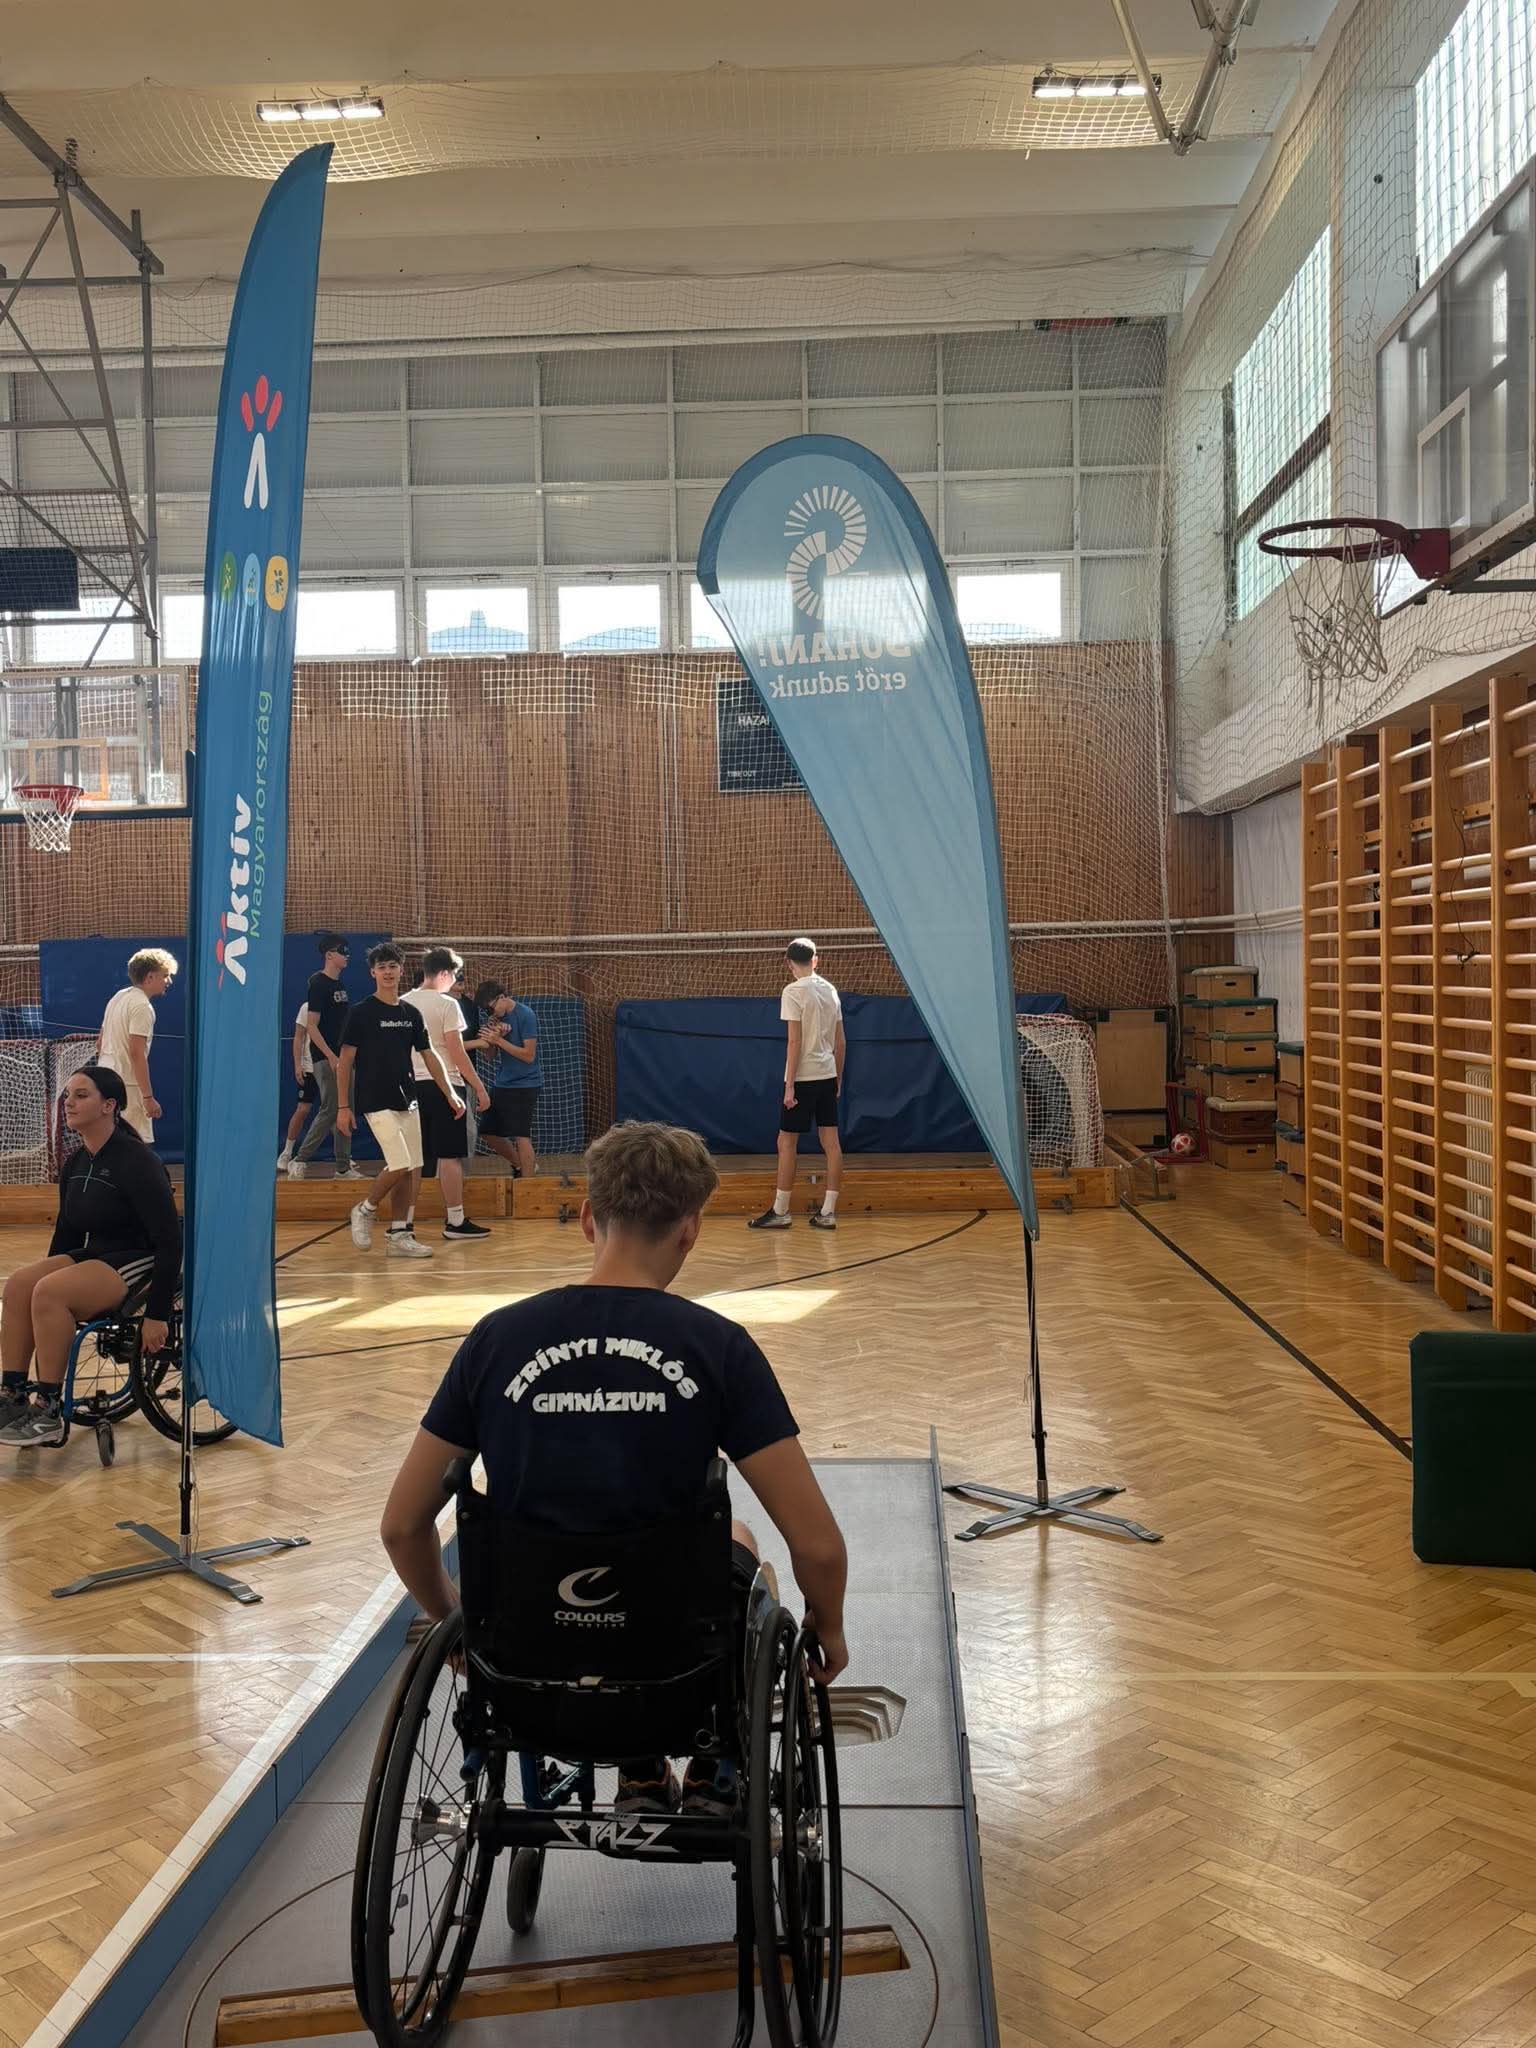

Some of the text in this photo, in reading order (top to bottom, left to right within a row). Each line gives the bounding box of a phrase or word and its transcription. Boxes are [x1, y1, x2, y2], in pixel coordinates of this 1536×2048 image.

[249, 691, 272, 937] Magyarország
[503, 1337, 700, 1403] ZRÍNYI MIKLÓS
[532, 1388, 666, 1413] GIMNÁZIUM
[554, 1610, 626, 1623] COLOURS
